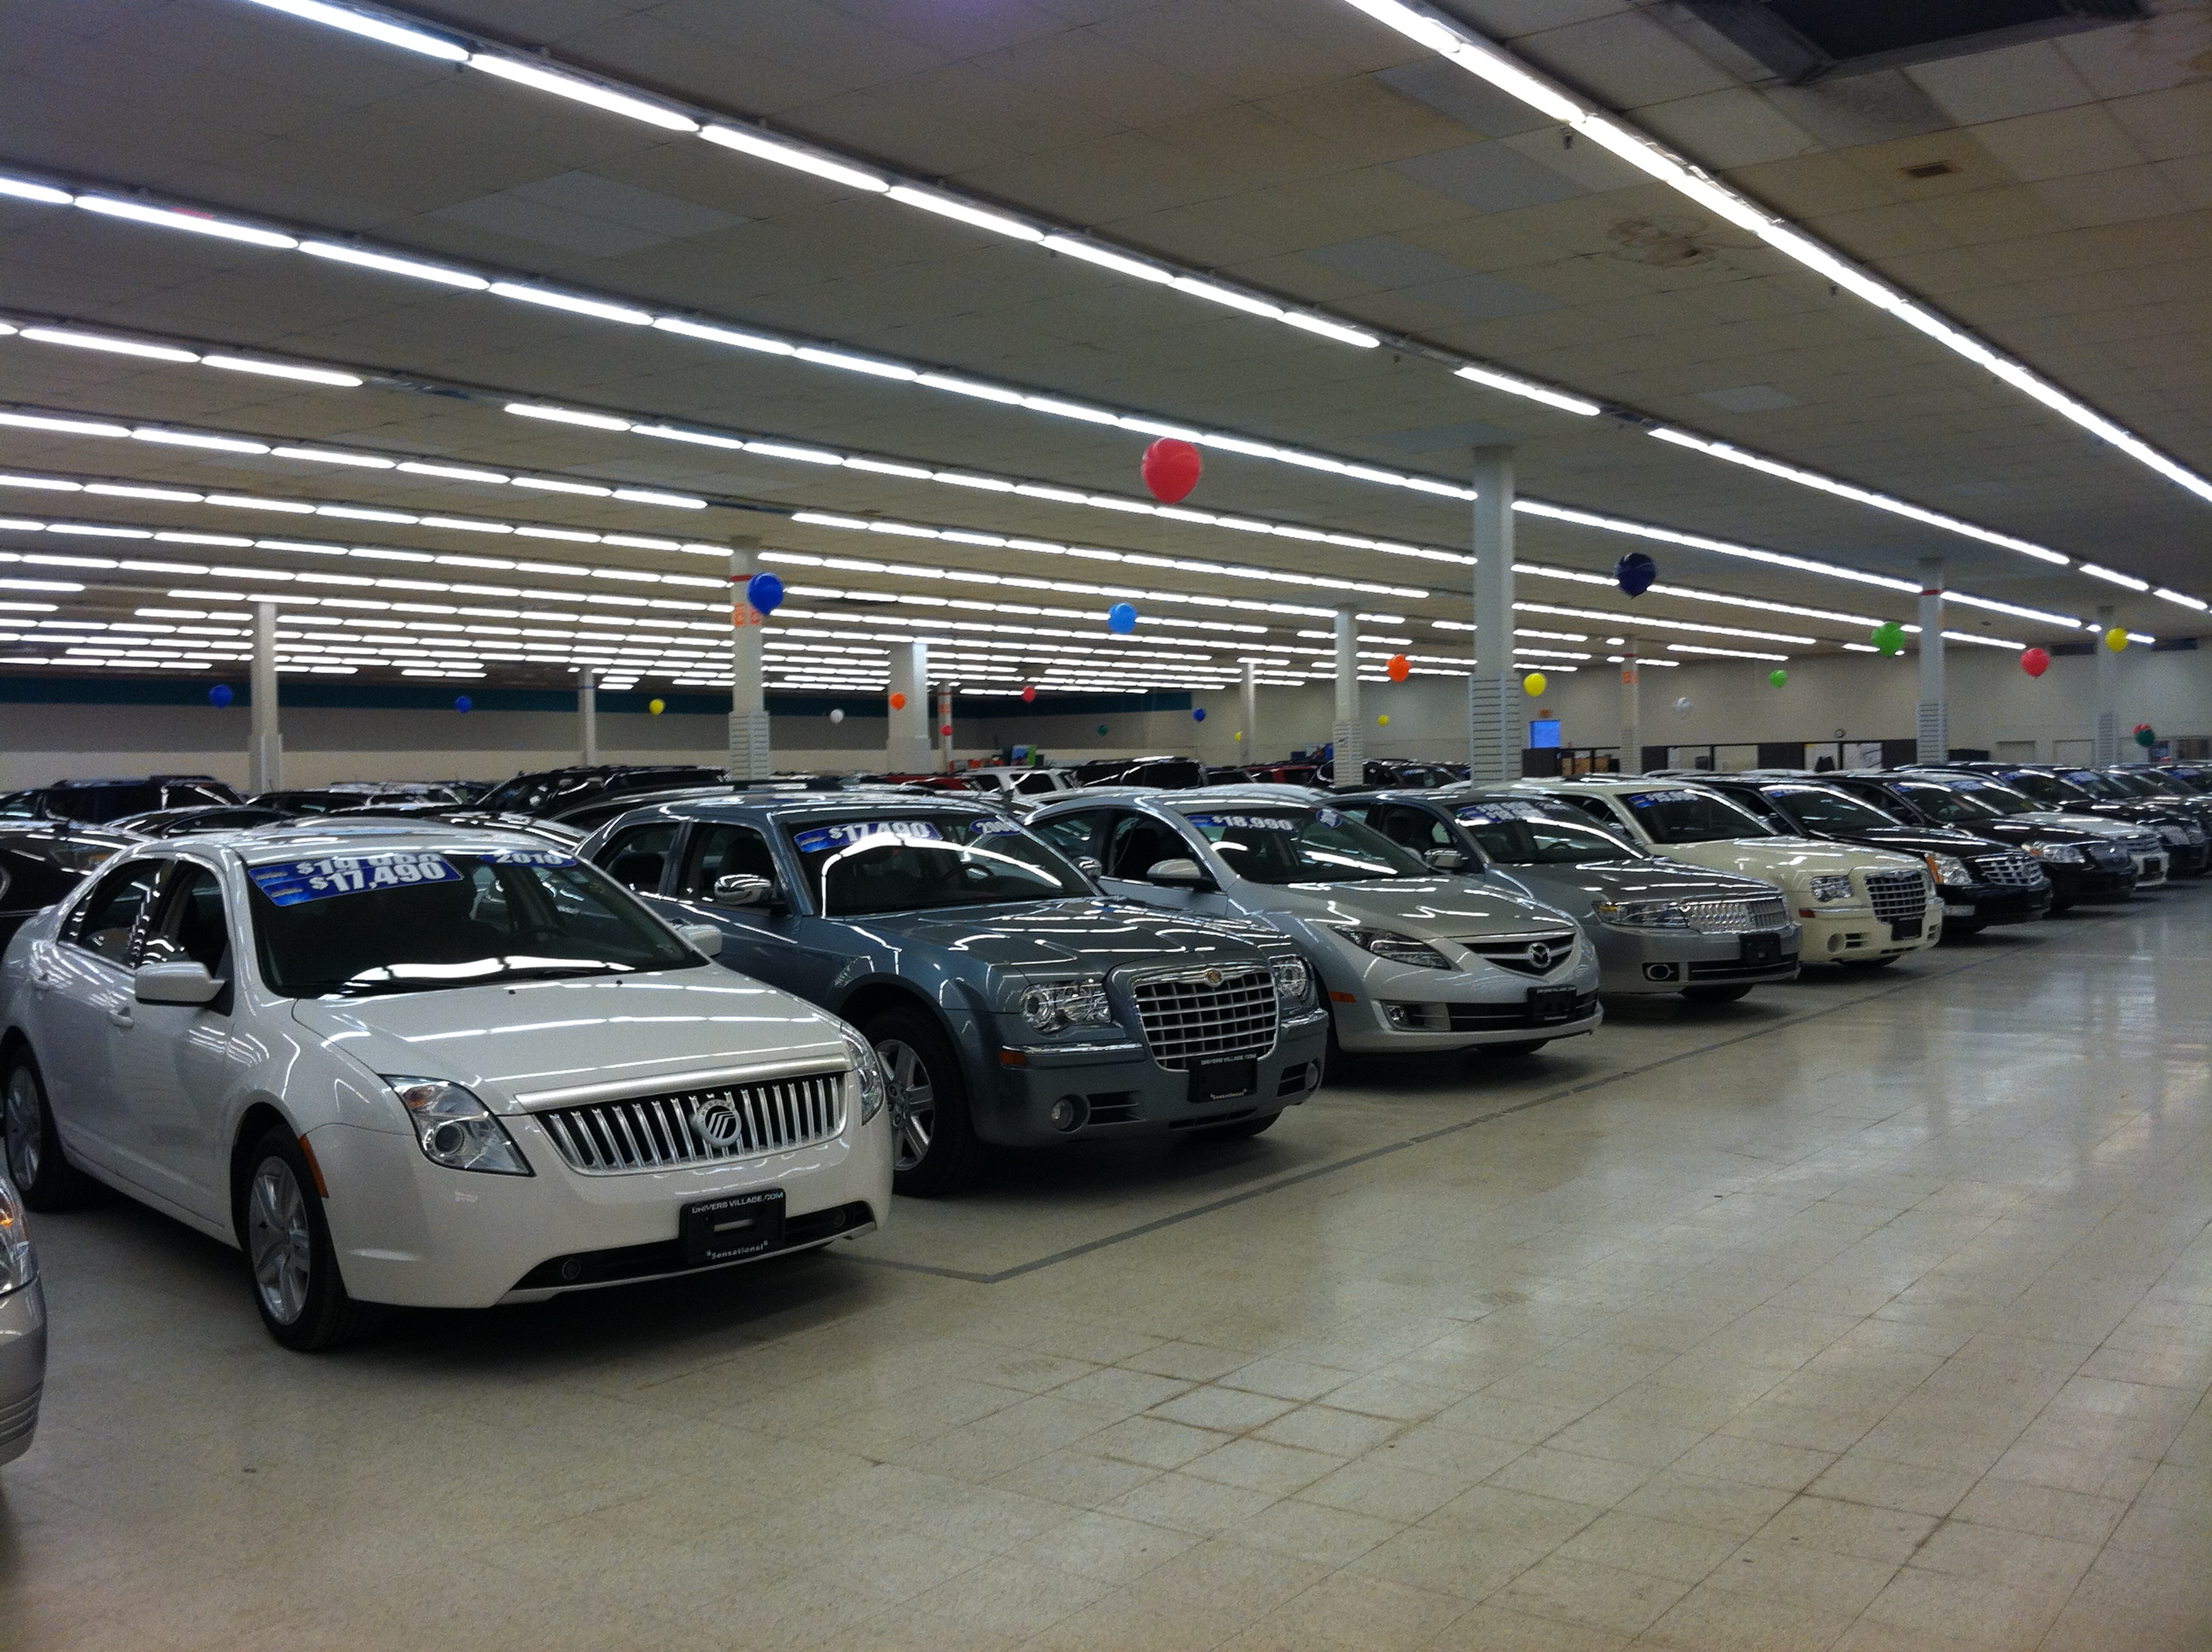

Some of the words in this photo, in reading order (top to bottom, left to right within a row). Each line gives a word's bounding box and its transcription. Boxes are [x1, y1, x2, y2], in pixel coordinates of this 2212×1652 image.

[828, 822, 931, 842] $17490
[495, 852, 563, 865] 2010
[309, 862, 446, 893] $17,490
[729, 1192, 783, 1207] VILLAGE.COM
